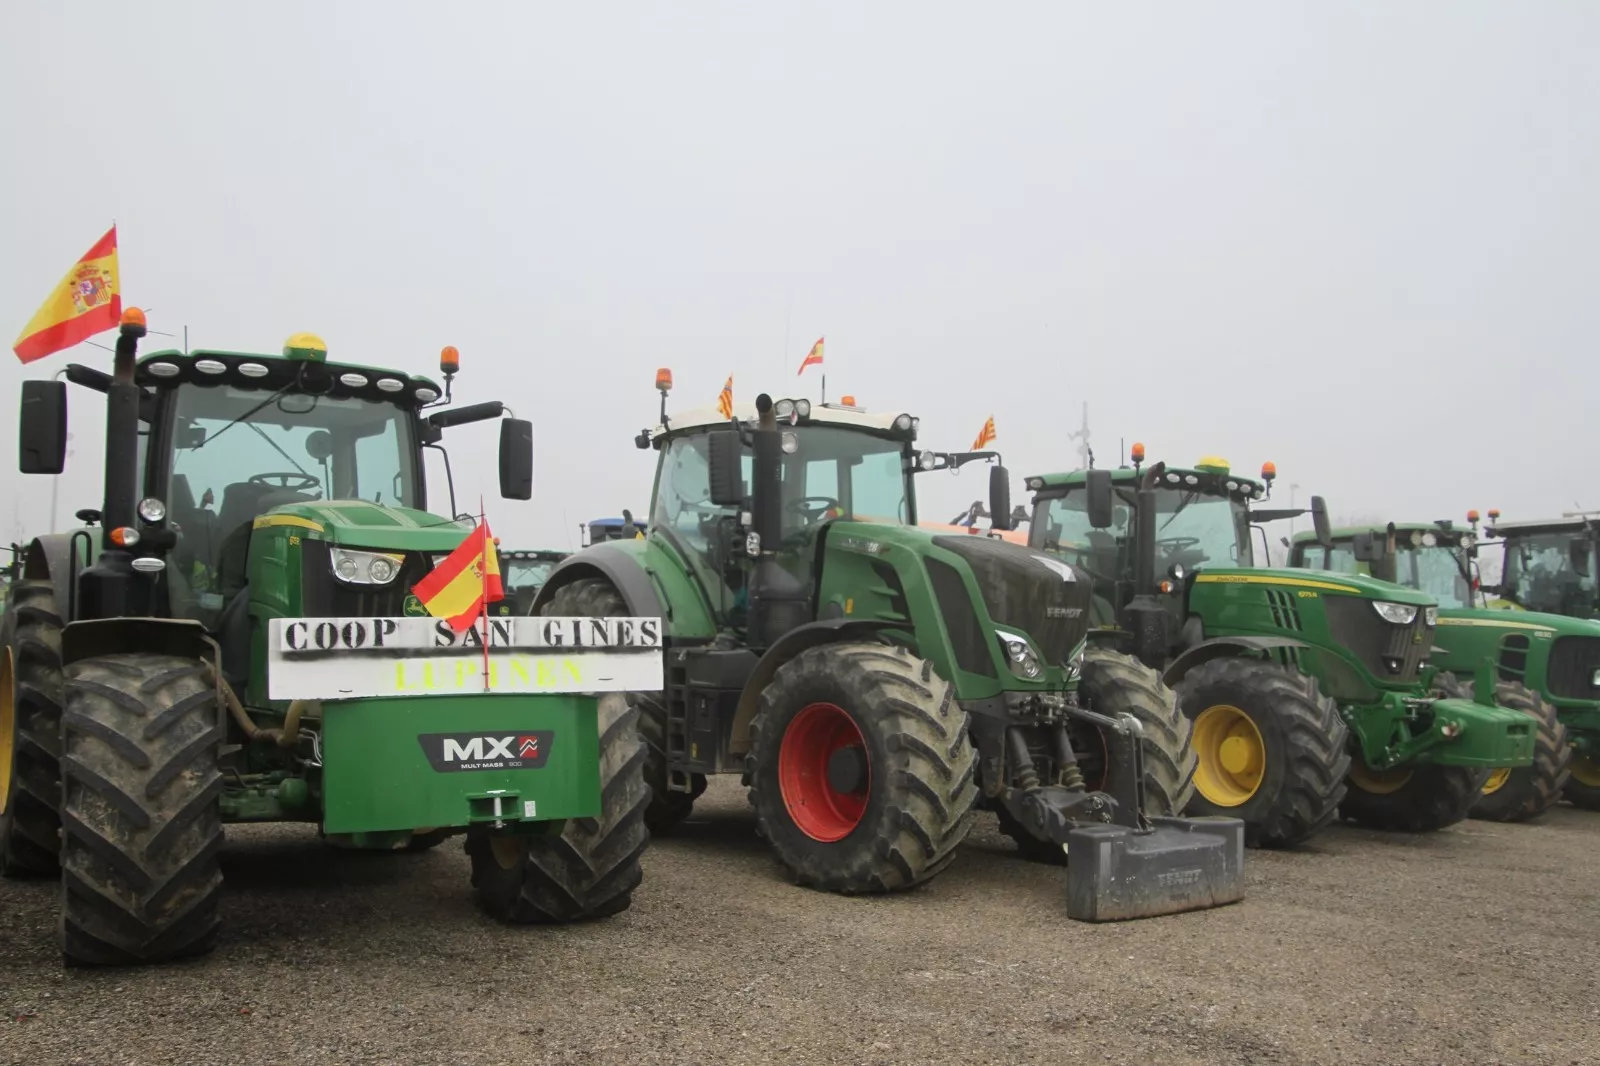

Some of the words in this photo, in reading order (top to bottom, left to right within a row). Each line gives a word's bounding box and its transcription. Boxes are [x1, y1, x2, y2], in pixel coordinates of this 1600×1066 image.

[1047, 607, 1082, 619] FENDT
[286, 619, 397, 649] COOP
[435, 619, 511, 647] SAN
[543, 619, 658, 647] GINES
[443, 736, 515, 761] MX
